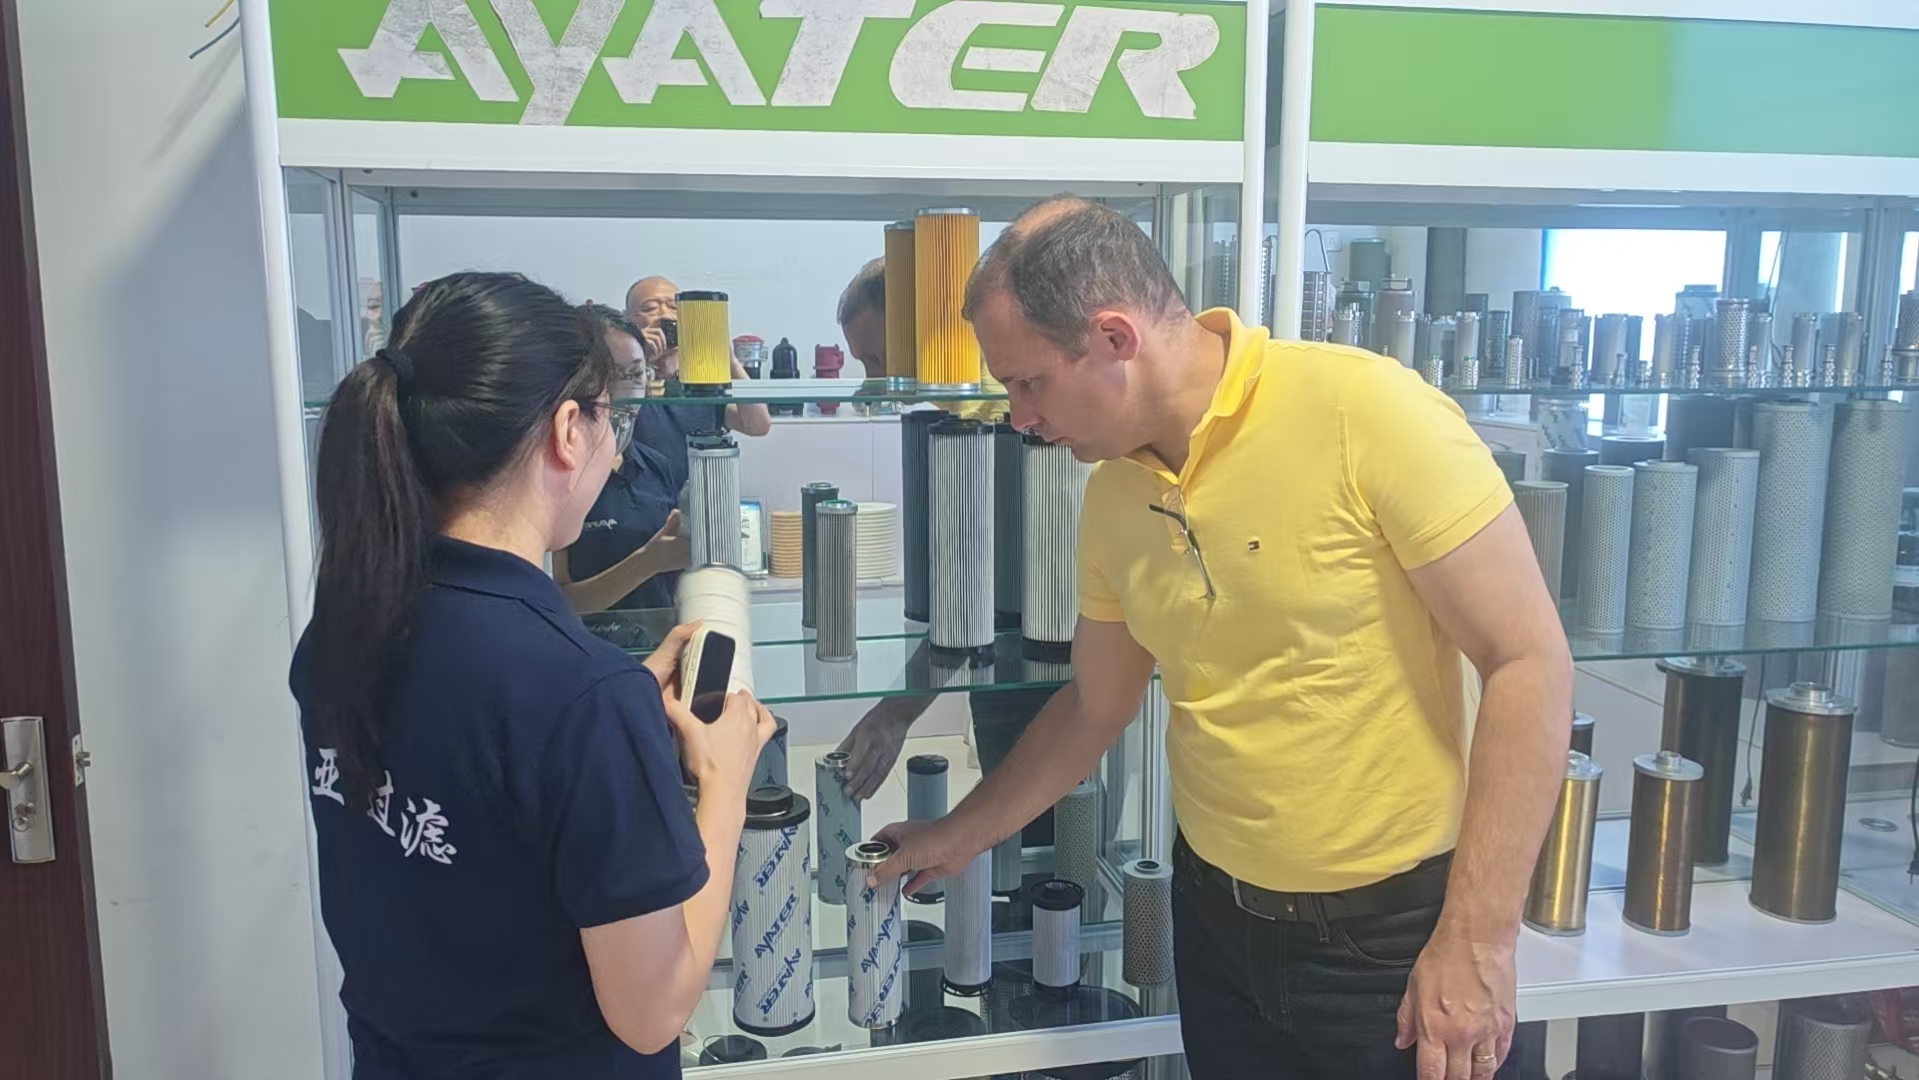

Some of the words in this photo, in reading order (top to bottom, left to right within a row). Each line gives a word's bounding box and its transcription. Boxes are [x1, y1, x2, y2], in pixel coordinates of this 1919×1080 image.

[338, 0, 1220, 126] AYATER
[754, 893, 799, 959] AYATER
[758, 948, 803, 1015] AYATER
